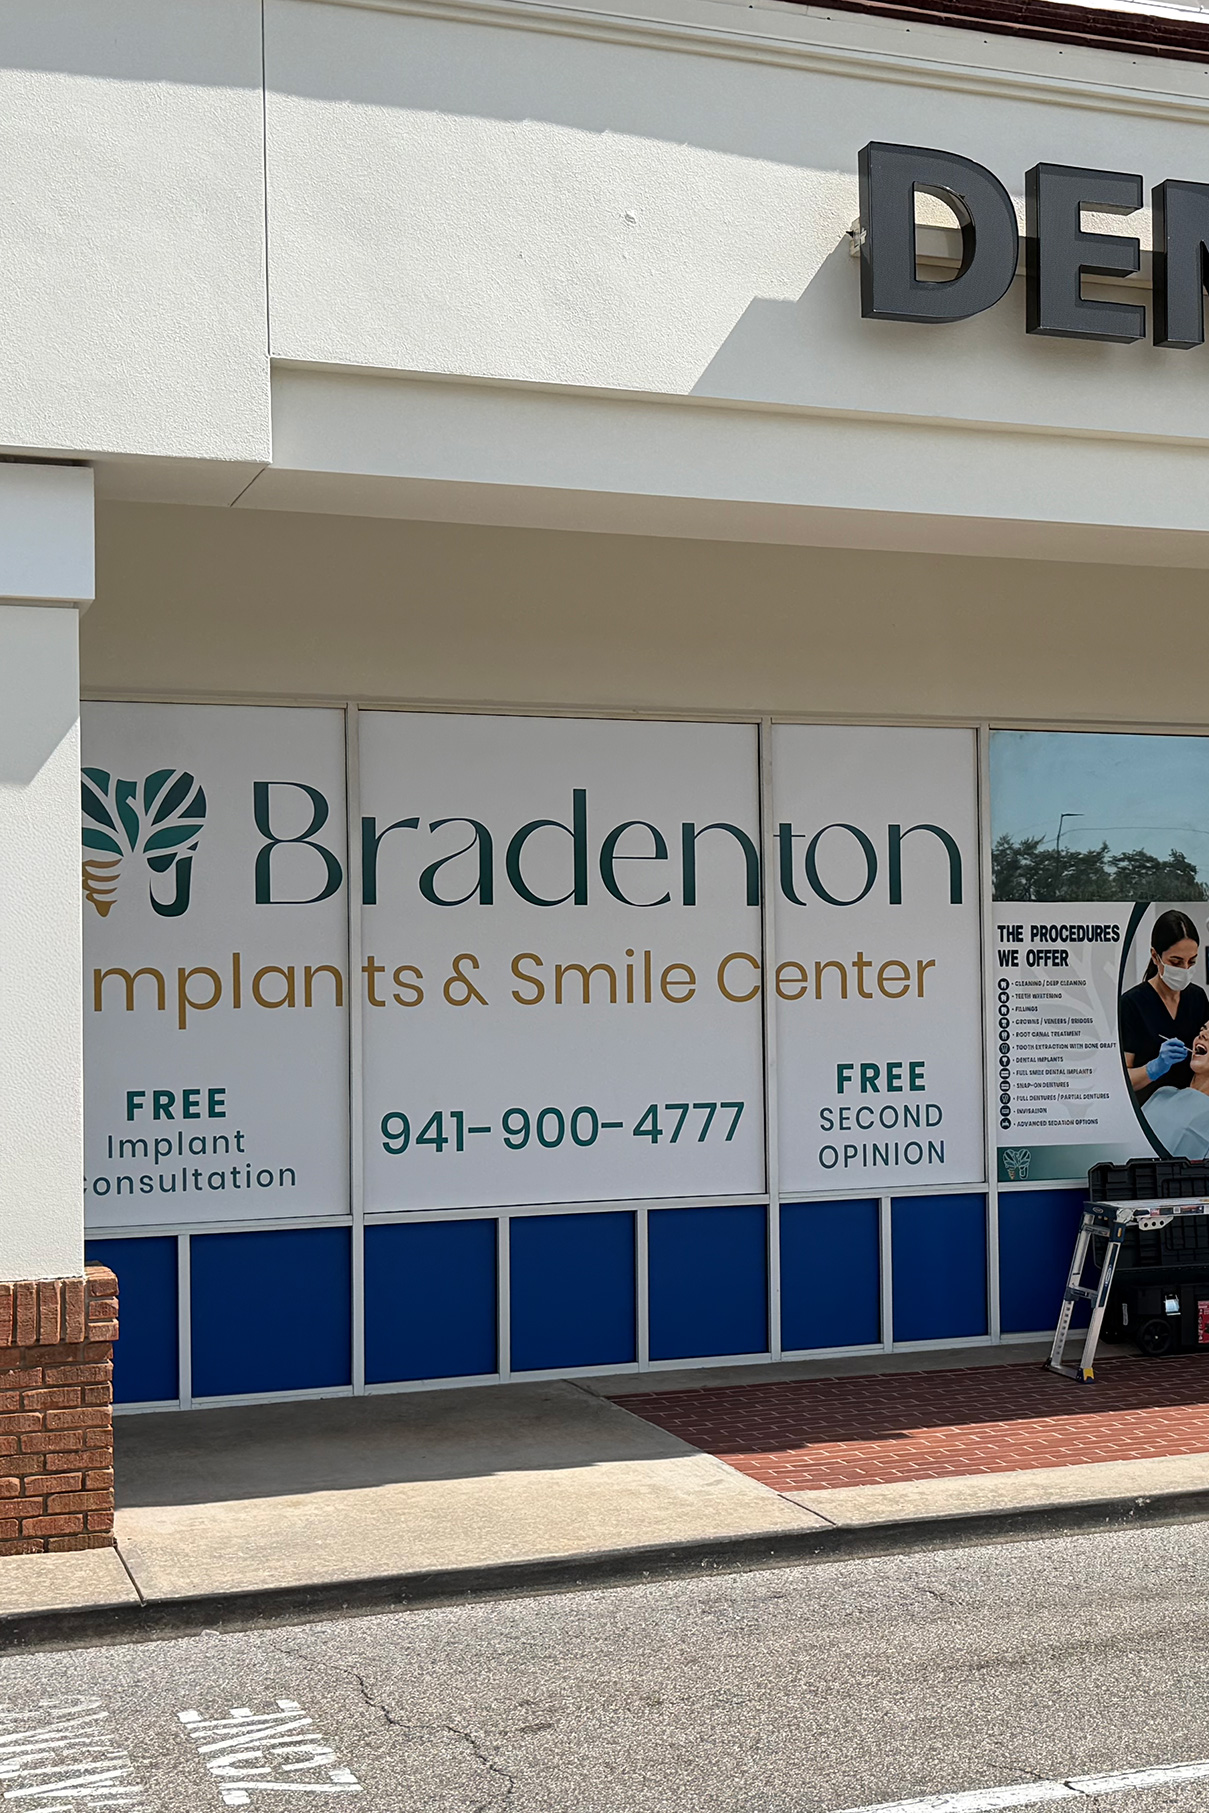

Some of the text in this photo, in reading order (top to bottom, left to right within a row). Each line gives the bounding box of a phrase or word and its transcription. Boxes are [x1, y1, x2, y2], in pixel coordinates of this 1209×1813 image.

[253, 780, 963, 908] Bradenton
[997, 924, 1120, 942] THE PROCEDURES
[998, 949, 1069, 967] WE OFFER
[93, 948, 936, 1030] mplants & Smile Center
[836, 1061, 926, 1094] FREE
[126, 1088, 227, 1121] FREE
[819, 1103, 943, 1132] SECOND
[381, 1101, 745, 1155] 941-900-4777
[107, 1129, 246, 1165] Implant
[818, 1140, 945, 1169] OPINION
[177, 1700, 364, 1805] ZONE
